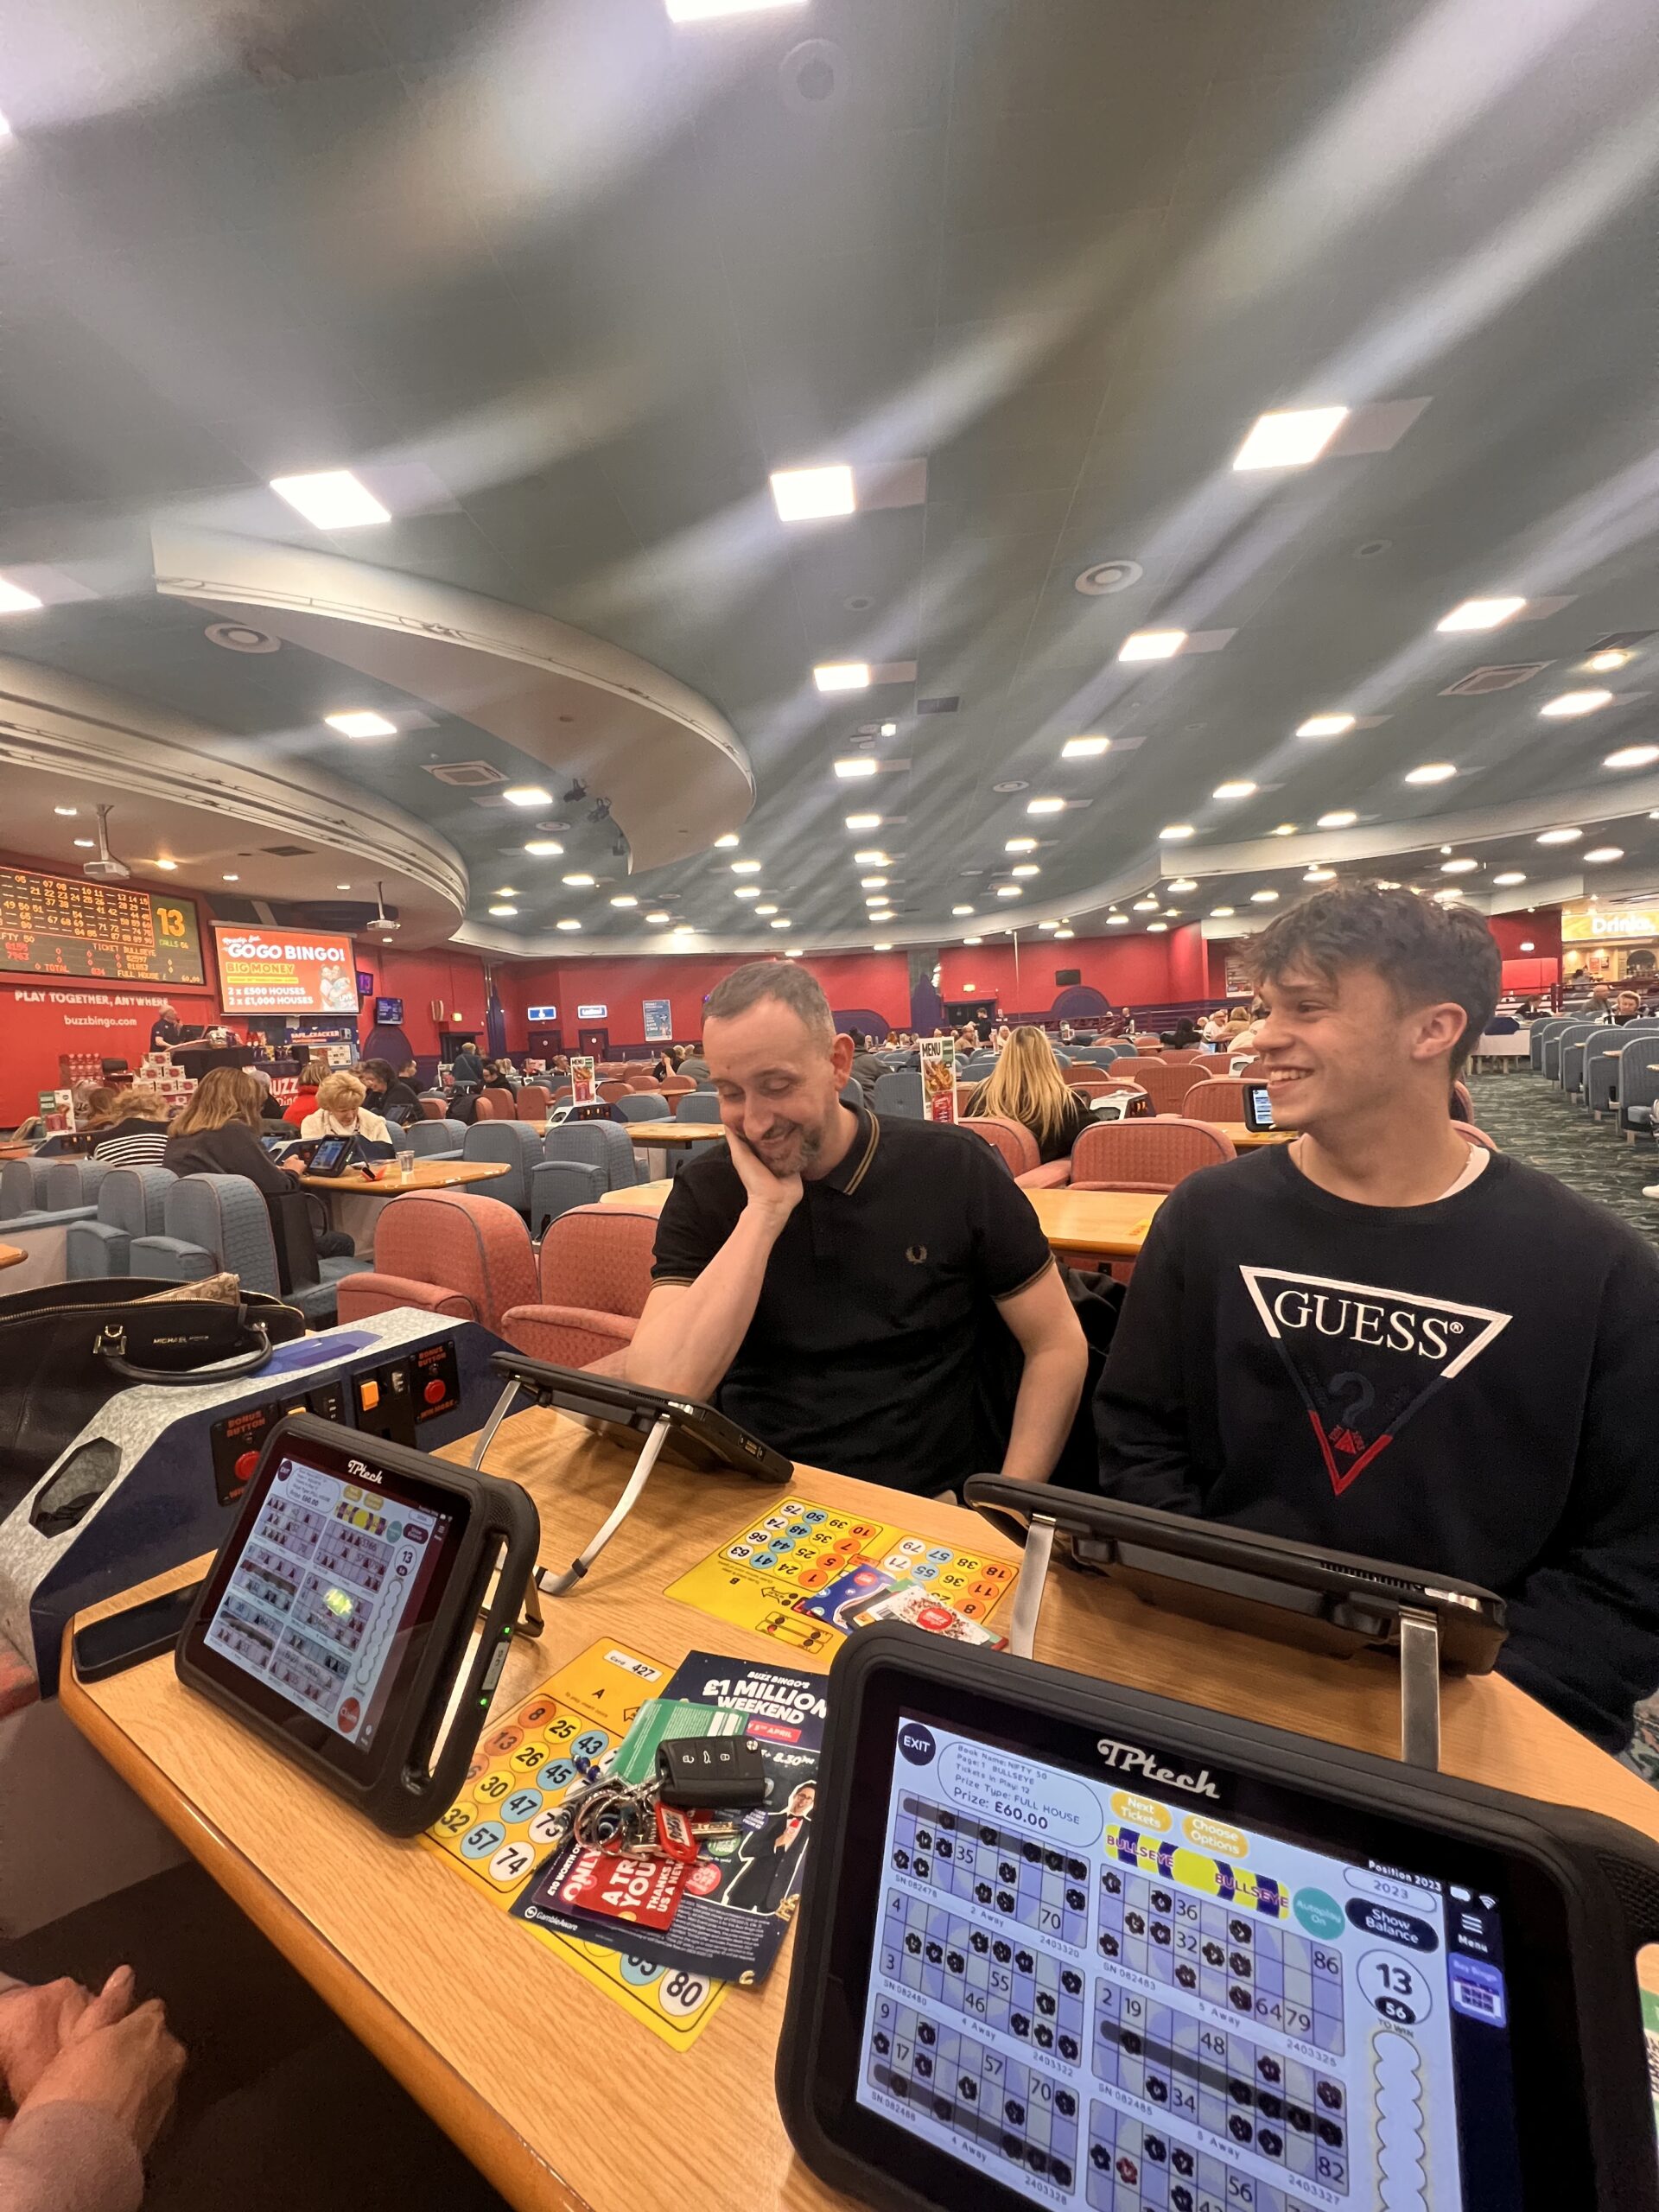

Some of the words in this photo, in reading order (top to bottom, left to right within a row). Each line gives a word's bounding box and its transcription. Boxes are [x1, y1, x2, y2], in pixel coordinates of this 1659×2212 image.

[18, 902, 29, 911] 50
[32, 905, 44, 913] 51
[157, 907, 185, 937] 13
[92, 943, 119, 952] TICKET
[159, 939, 179, 948] CALLS
[228, 944, 283, 959] GOGO
[284, 945, 345, 962] BINGO!
[44, 963, 69, 973] TOTAL
[118, 969, 135, 978] FULL
[138, 971, 159, 980] HOUSE
[226, 962, 249, 973] BIG
[251, 963, 295, 975] MONEY
[15, 990, 46, 1002] PLAY
[49, 991, 113, 1007] TOGETHER,
[115, 995, 168, 1007] ANYWHERE
[277, 996, 314, 1005] HOUSES
[64, 1015, 137, 1027] buzzbingo.com
[921, 1042, 941, 1057] MENU
[226, 1419, 265, 1437] BUTTON
[227, 1411, 263, 1427] BONUS
[347, 1459, 383, 1484] TPtech
[784, 1504, 802, 1515] 75
[806, 1512, 824, 1522] 50
[766, 1518, 785, 1529] 74
[789, 1526, 807, 1535] 48
[830, 1519, 849, 1529] 39
[853, 1526, 870, 1536] 10
[772, 1540, 791, 1550] 44
[813, 1533, 832, 1544] 35
[731, 1546, 750, 1557] 63
[754, 1555, 773, 1566] 41
[796, 1548, 817, 1559] 25
[778, 1564, 799, 1575] 24
[888, 1557, 906, 1568] 71
[915, 1566, 936, 1577] 55
[943, 1575, 965, 1586] 36
[986, 1567, 1006, 1579] 18
[610, 1656, 626, 1666] Card
[632, 1663, 656, 1679] 427
[747, 1671, 770, 1681] BUZZ
[591, 1688, 606, 1700] A
[702, 1680, 731, 1696] £1
[733, 1680, 827, 1719] MILLION
[717, 1696, 804, 1725] WEEKEND
[529, 1707, 545, 1720] 8
[550, 1719, 576, 1738] 25
[578, 1736, 603, 1755] 43
[766, 1726, 792, 1738] APRIL
[903, 1735, 931, 1752] EXIT
[493, 1732, 518, 1750] 13
[516, 1747, 543, 1767] 26
[546, 1764, 572, 1784] 45
[958, 1745, 978, 1757] Book
[982, 1752, 1007, 1766] Name:
[1007, 1762, 1033, 1775] NIFTY
[957, 1753, 979, 1768] Page:
[992, 1765, 1034, 1785] BULLSEYE
[957, 1764, 986, 1778] Tickets
[999, 1777, 1019, 1791] Play:
[1097, 1738, 1220, 1799] TPtech
[480, 1777, 508, 1798] 30
[510, 1796, 537, 1815] 47
[954, 1786, 989, 1808] Prize:
[956, 1774, 980, 1789] Prize
[984, 1783, 1011, 1800] Type:
[1014, 1795, 1039, 1811] FULL
[1043, 1805, 1080, 1824] HOUSE
[1127, 1796, 1154, 1815] Next
[1121, 1805, 1161, 1828] Tickets
[1192, 1818, 1238, 1841] Choose
[441, 1808, 470, 1833] 32
[467, 1827, 499, 1851] 57
[497, 1847, 528, 1874] 74
[1107, 1834, 1174, 1868] BULLSEYE
[1190, 1830, 1240, 1854] Options
[956, 1846, 975, 1864] 35
[547, 1882, 558, 1896] £10
[555, 1853, 574, 1884] WORTH
[563, 1850, 601, 1901] ONLY
[1368, 1859, 1412, 1884] Position
[1414, 1874, 1442, 1892] 2023
[646, 1864, 672, 1910] THANKS
[1215, 1872, 1289, 1908] BULLSEYE
[1373, 1879, 1409, 1900] 2023
[601, 1891, 623, 1905] A
[657, 1897, 671, 1912] US
[666, 1886, 676, 1896] A
[892, 1898, 901, 1913] 4
[537, 1912, 578, 1931] GambleAware
[980, 1911, 1005, 1927] Away
[1041, 1909, 1062, 1929] 70
[1296, 1899, 1341, 1924] Autoplay
[1311, 1914, 1327, 1927] On
[1371, 1907, 1411, 1930] Show
[1176, 1900, 1198, 1921] 36
[1313, 1950, 1339, 1974] 86
[1365, 1916, 1420, 1944] Balance
[1039, 1936, 1080, 1958] 2403320
[1176, 1930, 1198, 1954] 32
[1458, 1933, 1488, 1953] Menu
[667, 1972, 702, 2006] 80
[886, 1955, 895, 1970] 3
[965, 1992, 986, 2013] 46
[990, 1972, 1010, 1992] 55
[1376, 1962, 1414, 1996] 13
[1211, 2006, 1241, 2028] Away
[1255, 1997, 1283, 2022] 64
[1285, 2009, 1311, 2031] 79
[1385, 2002, 1408, 2020] 56
[1103, 1988, 1113, 2005] 2
[1124, 1998, 1141, 2018] 19
[1200, 2032, 1226, 2056] 48
[1378, 2018, 1393, 2031] TO
[1394, 2024, 1414, 2038] WIN
[880, 2003, 890, 2019] 9
[984, 2055, 1003, 2075] 57
[1031, 2077, 1052, 2101] 70
[896, 2043, 909, 2061] 17
[1173, 2088, 1197, 2113] 34
[1318, 2156, 1344, 2185] 82
[1229, 2176, 1254, 2202] 56
[1288, 2177, 1340, 2205] 2403327
